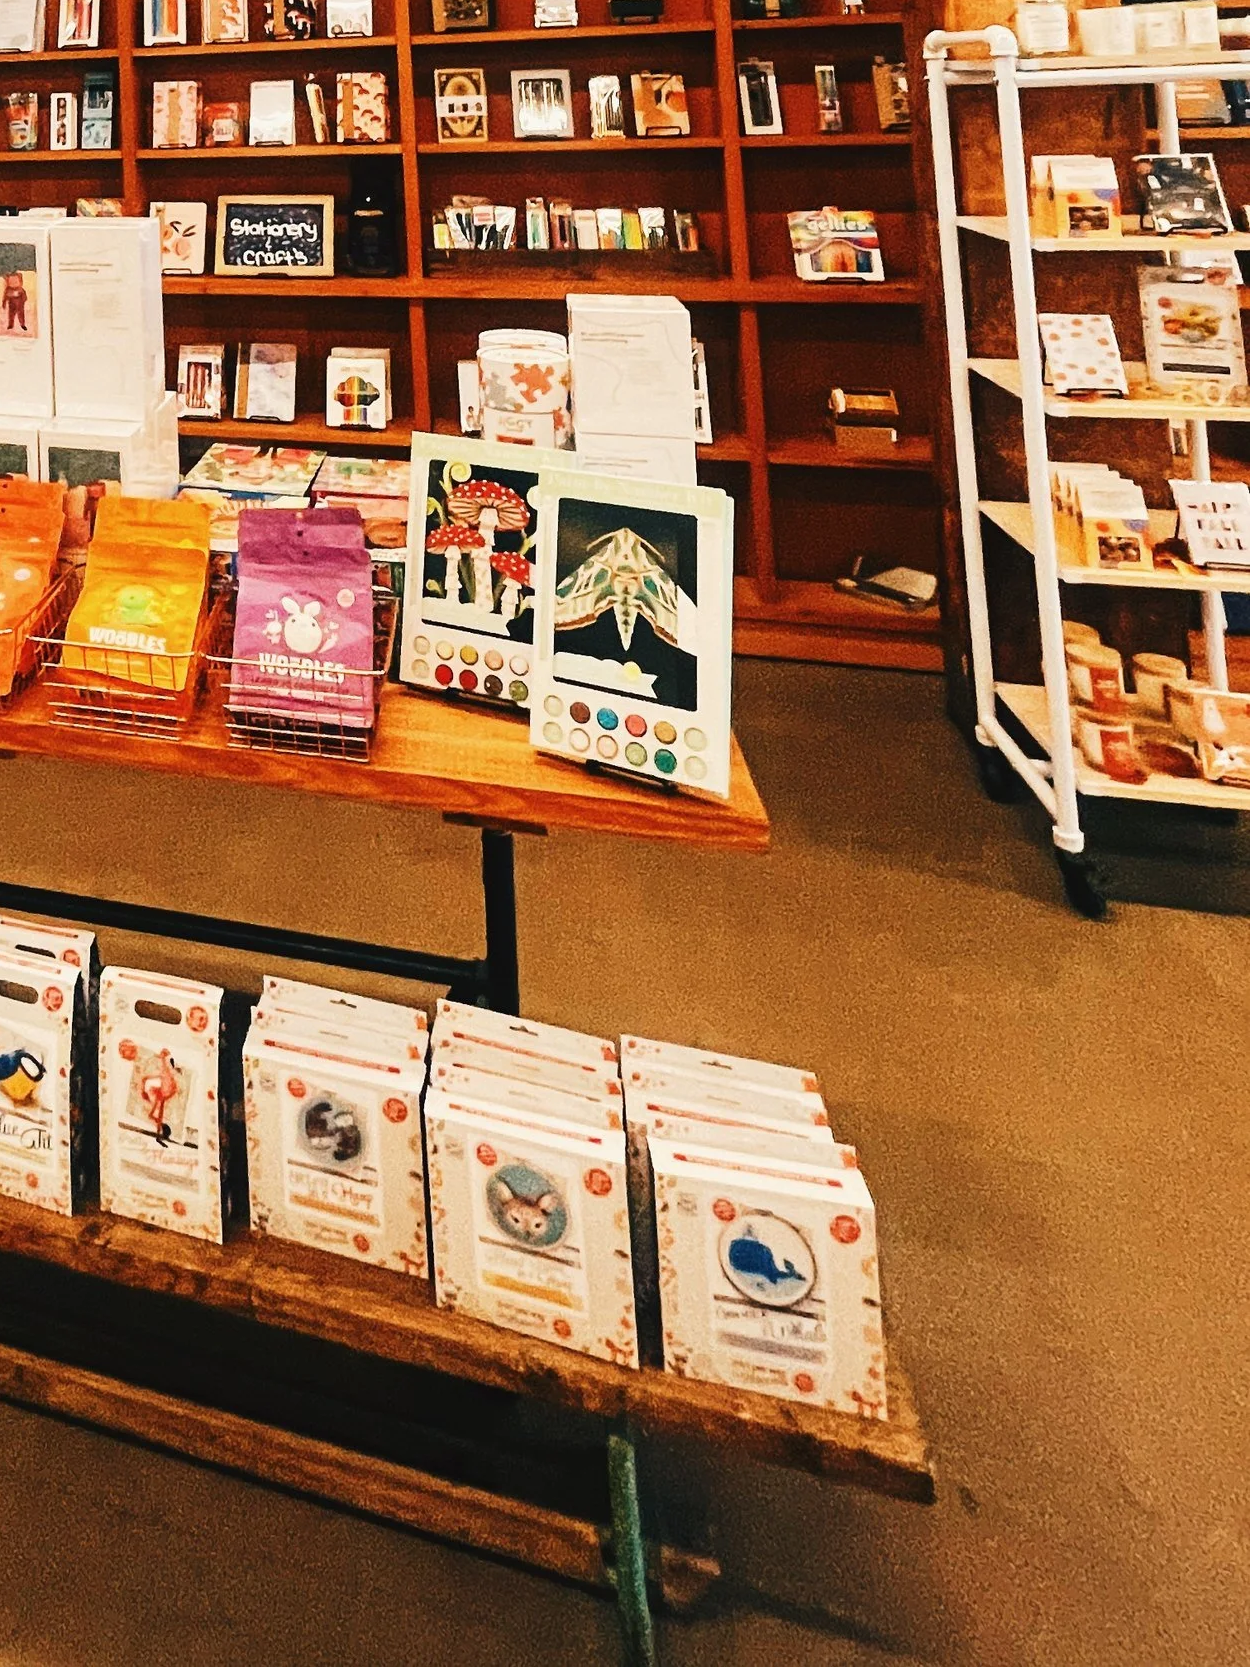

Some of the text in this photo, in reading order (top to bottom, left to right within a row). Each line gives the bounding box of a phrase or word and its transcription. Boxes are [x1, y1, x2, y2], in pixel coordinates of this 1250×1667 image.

[230, 218, 318, 243] Stationery
[89, 626, 167, 653] WOOBLES
[258, 652, 346, 684] WOOBLES
